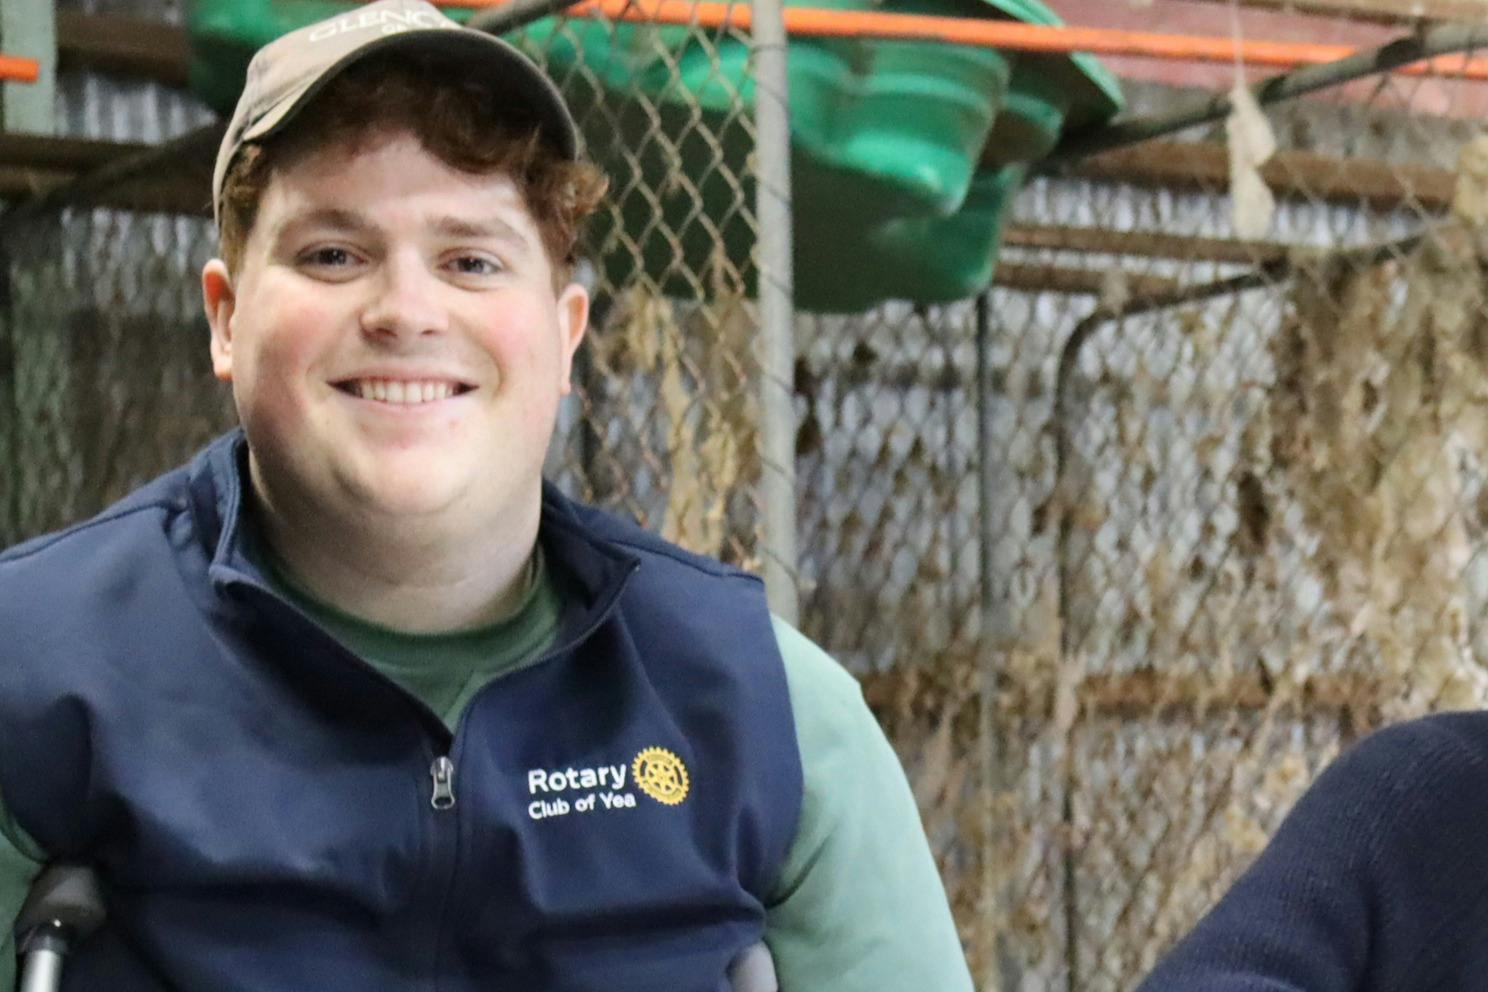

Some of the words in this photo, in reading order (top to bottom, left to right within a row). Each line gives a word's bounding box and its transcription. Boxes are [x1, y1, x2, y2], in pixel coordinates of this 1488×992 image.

[528, 764, 627, 794] Rotary
[528, 798, 571, 820] Club
[575, 794, 596, 812] of
[600, 791, 637, 810] Yea
